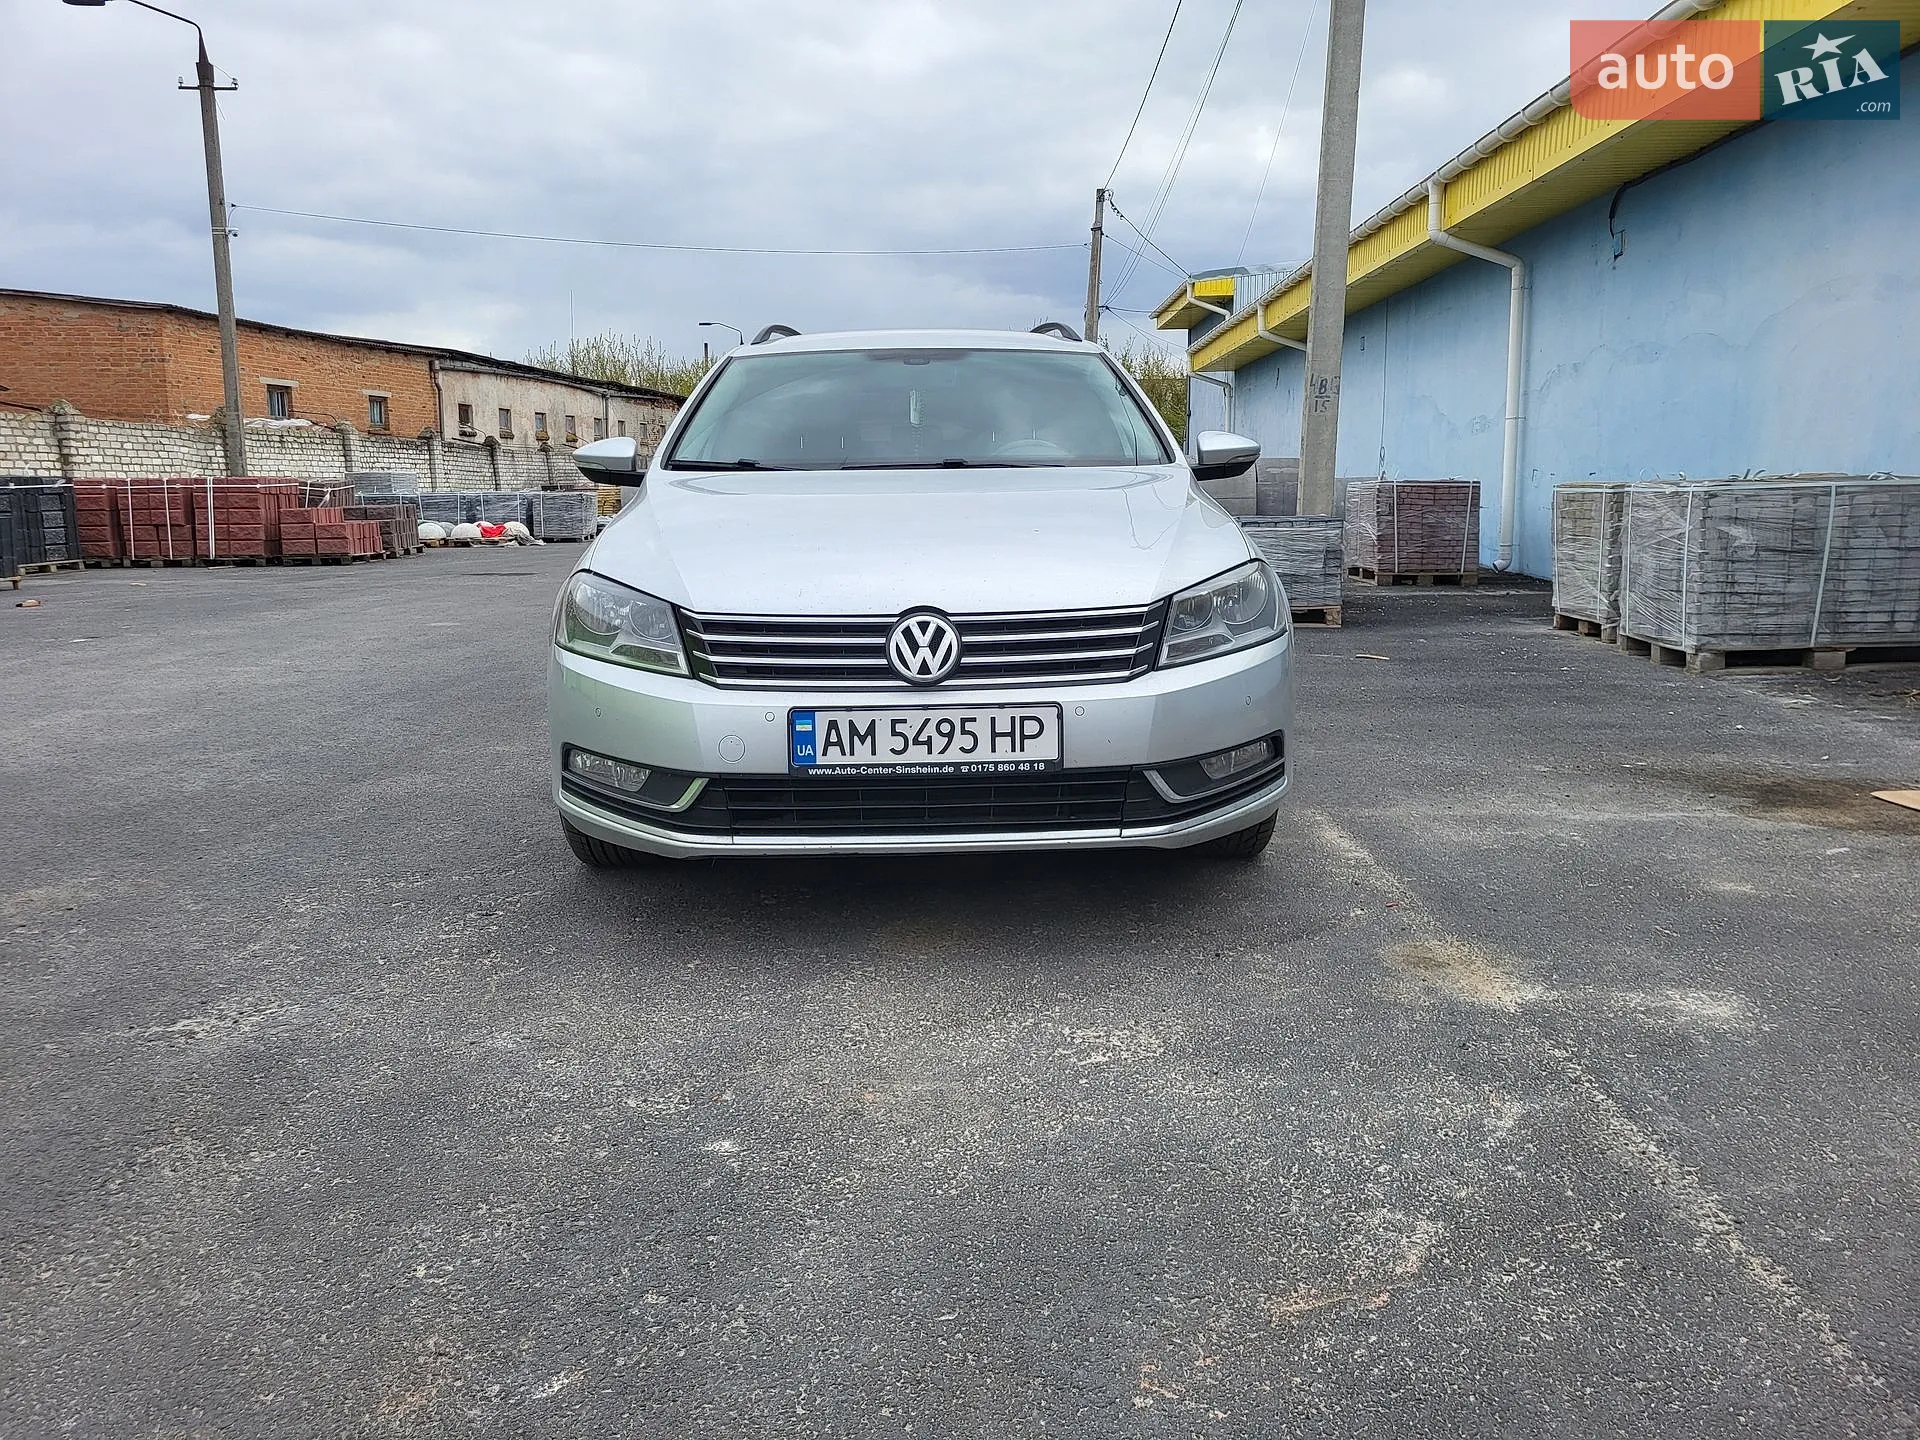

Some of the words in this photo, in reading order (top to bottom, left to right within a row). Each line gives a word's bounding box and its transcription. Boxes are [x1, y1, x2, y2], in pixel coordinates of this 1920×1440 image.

[821, 718, 877, 757] AM
[889, 717, 979, 755] 5495
[990, 715, 1045, 753] HP
[797, 744, 814, 756] UA
[808, 765, 955, 775] www.Auto-Center-Sinsheim.de
[970, 763, 995, 772] 0175
[997, 762, 1016, 772] 860
[1017, 762, 1031, 771] 48
[1033, 762, 1046, 771] 18
